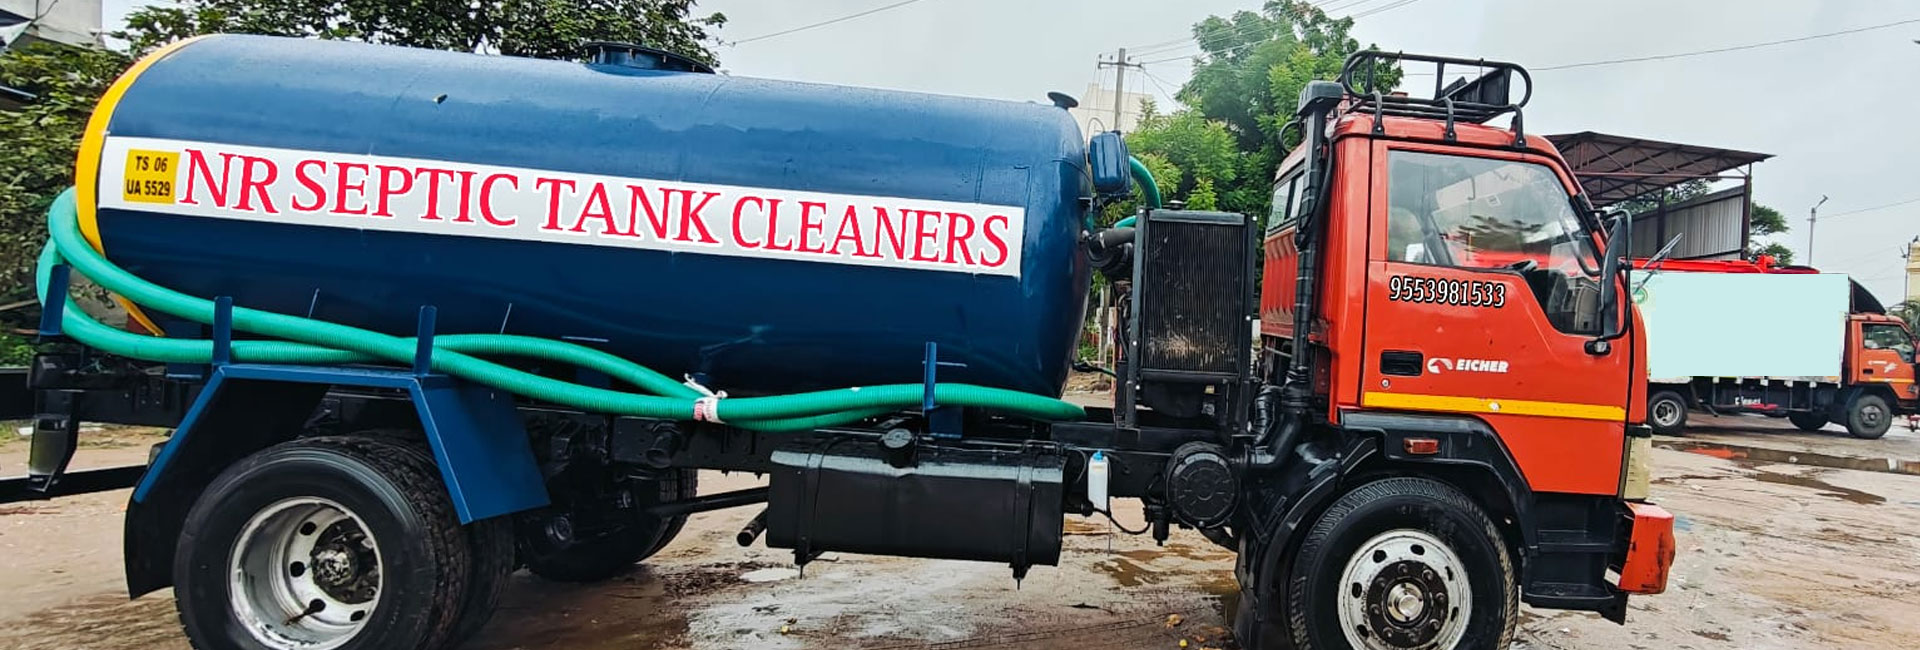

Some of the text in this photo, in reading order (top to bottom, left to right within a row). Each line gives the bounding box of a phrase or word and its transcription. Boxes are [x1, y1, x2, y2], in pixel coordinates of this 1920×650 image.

[136, 156, 168, 172] TS 06
[126, 179, 171, 196] UA 5529
[179, 148, 1010, 268] NR SEPTIC TANK CLEANERS
[1389, 275, 1506, 308] 9553981533
[1455, 358, 1510, 374] EICHER
